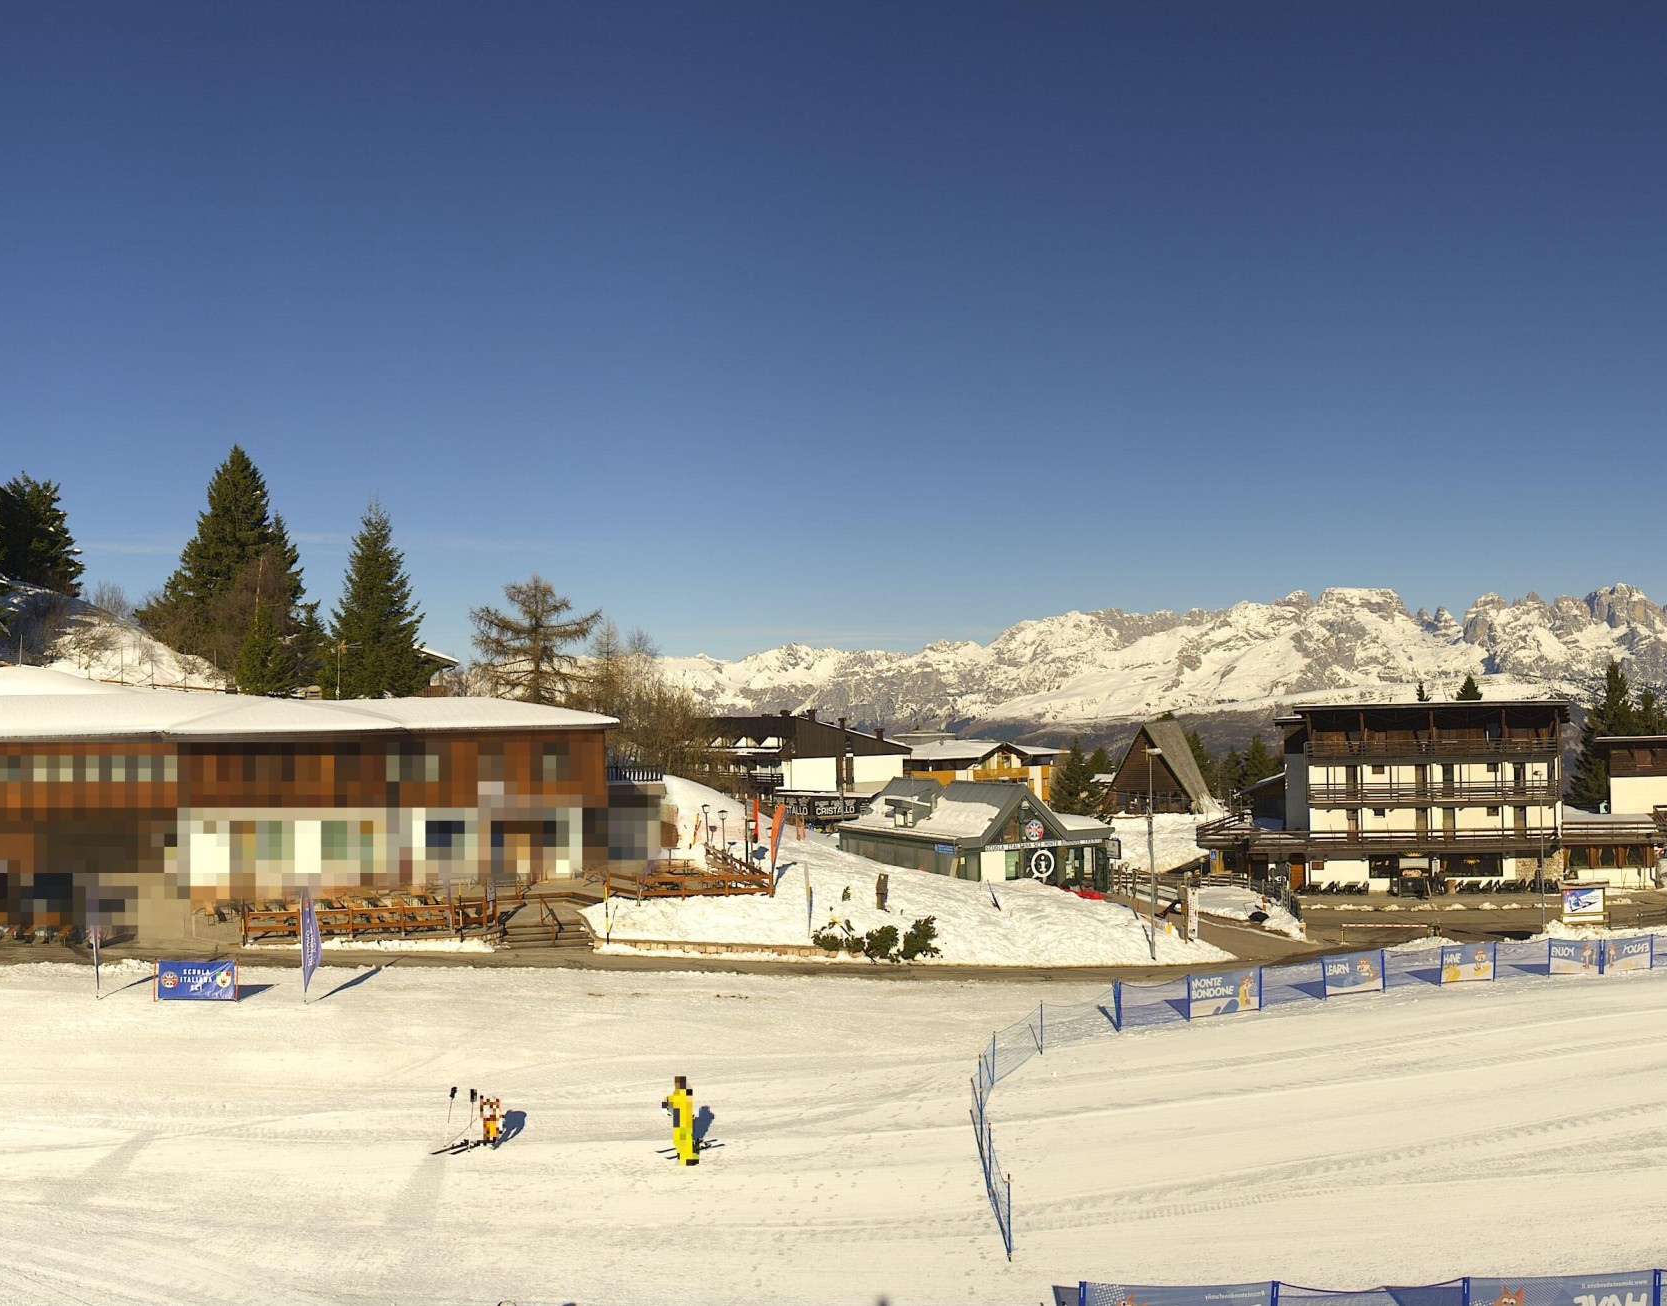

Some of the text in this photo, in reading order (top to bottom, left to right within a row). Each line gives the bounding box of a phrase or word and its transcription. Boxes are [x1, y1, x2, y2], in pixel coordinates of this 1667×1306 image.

[1443, 952, 1462, 964] HAVE
[1325, 963, 1350, 976] LEARN
[1191, 976, 1223, 989] MONTE
[1191, 985, 1234, 999] BONDONE
